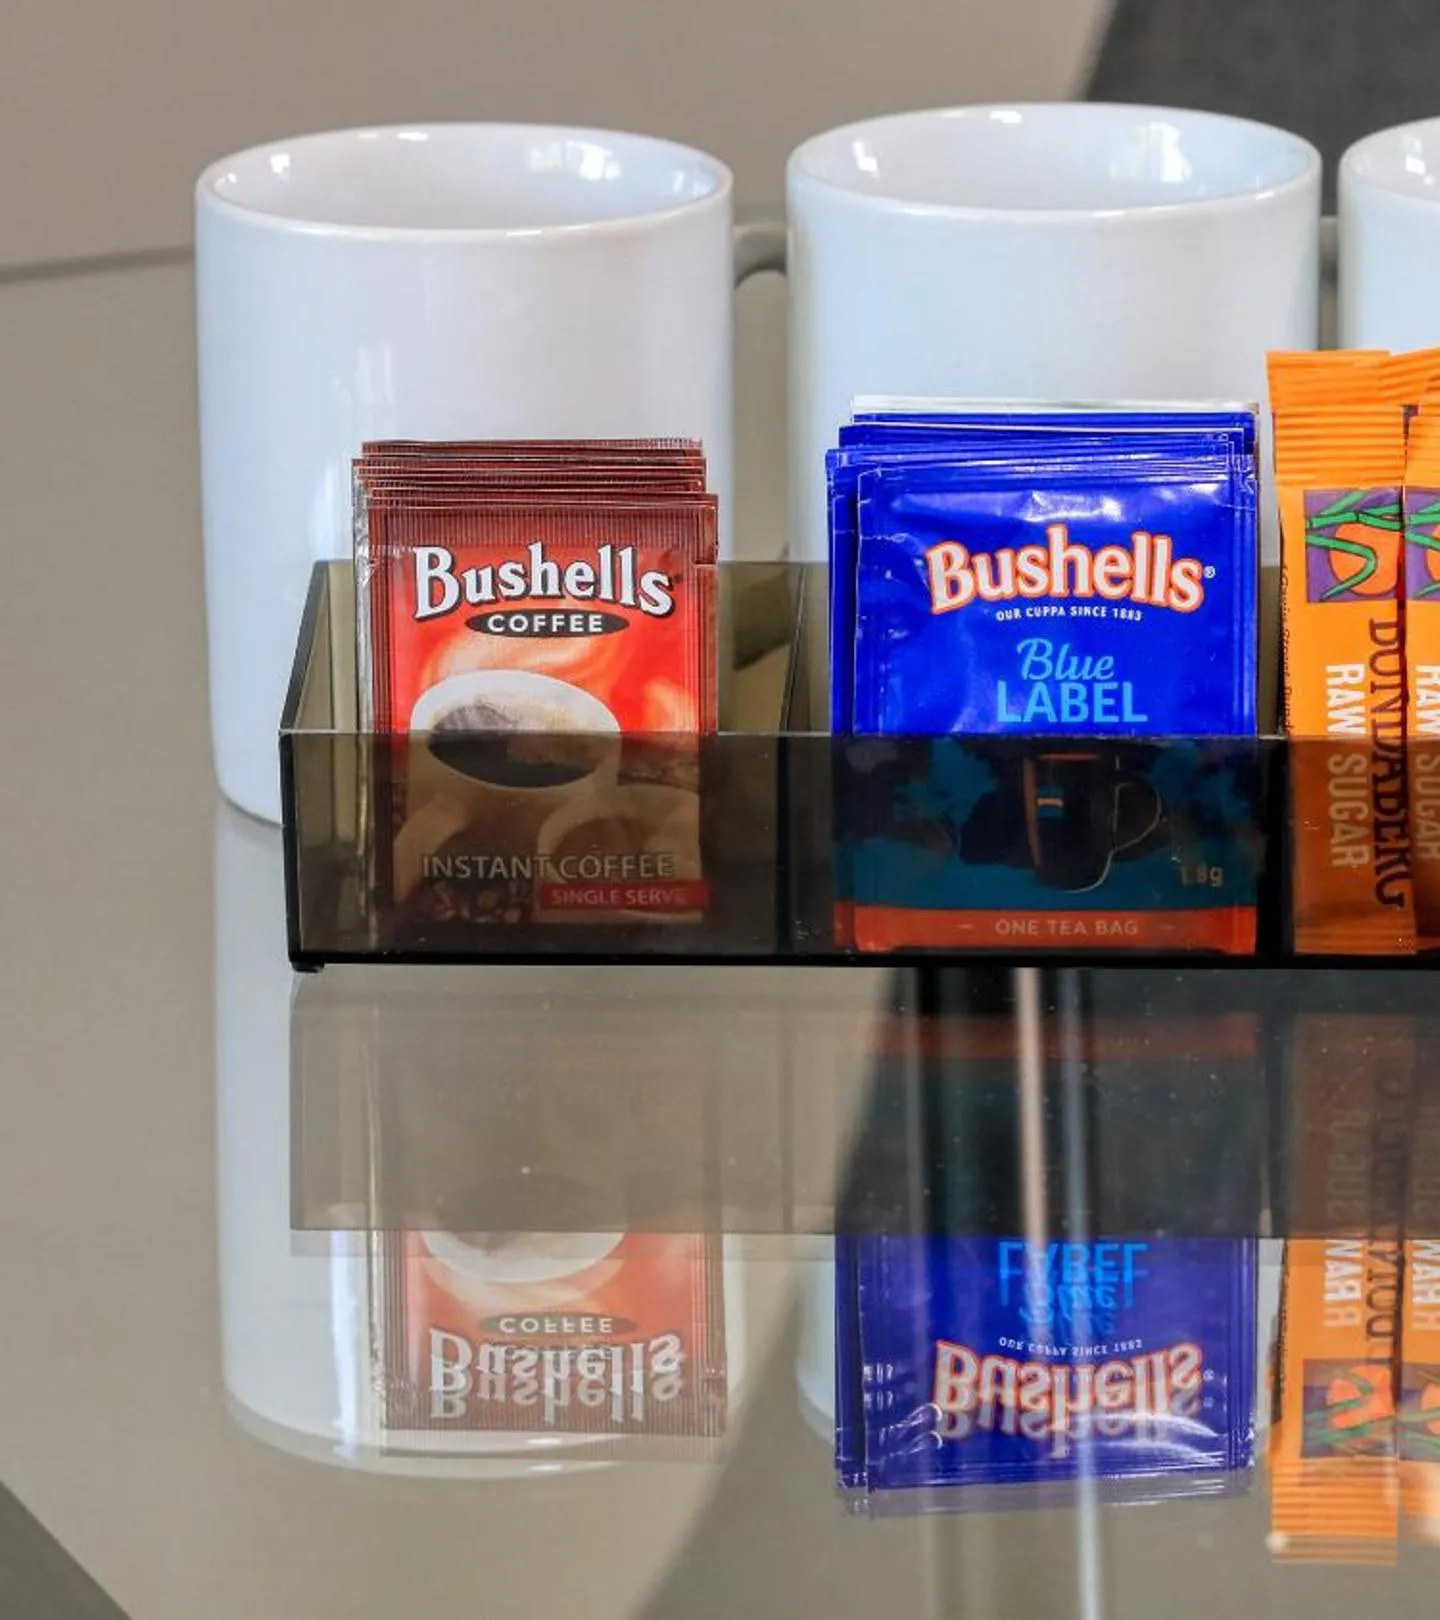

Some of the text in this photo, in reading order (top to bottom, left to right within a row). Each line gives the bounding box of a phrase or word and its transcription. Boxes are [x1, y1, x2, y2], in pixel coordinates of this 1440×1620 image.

[412, 541, 676, 622] Bushells
[487, 614, 603, 632] COFFEE
[996, 606, 1142, 621] OUR CUPPA SINCE 1883
[1017, 638, 1115, 681] Blue
[997, 681, 1148, 723] LABEL
[1325, 663, 1371, 868] RAW SUGAR
[423, 853, 676, 880] INSTANT COFFEE
[551, 888, 690, 906] SINGLE SERVE
[995, 919, 1139, 936] ONE TEA BAG
